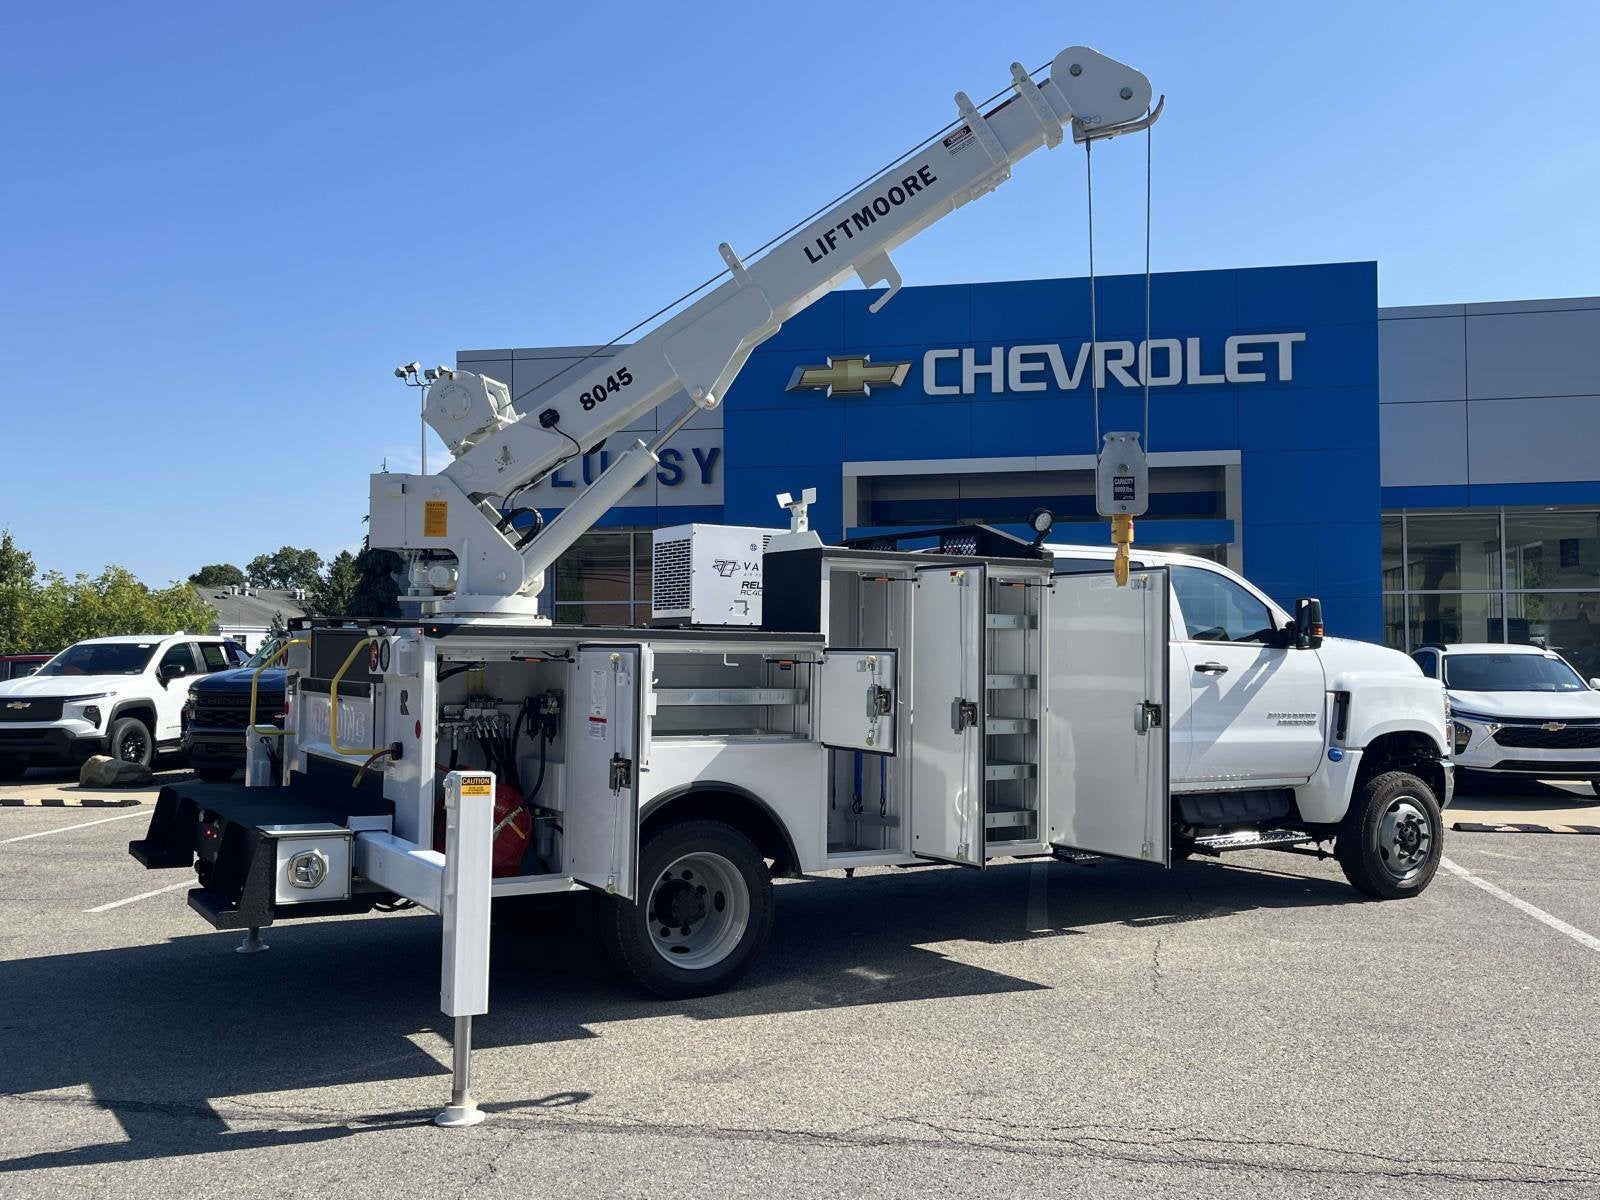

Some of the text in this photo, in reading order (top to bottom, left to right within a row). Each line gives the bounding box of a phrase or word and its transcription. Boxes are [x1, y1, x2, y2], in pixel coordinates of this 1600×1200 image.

[803, 164, 938, 264] LIFTMOORE
[922, 332, 1307, 395] CHEVROLET
[579, 366, 633, 411] 8045
[551, 447, 721, 488] LUSY
[462, 777, 490, 785] CAUTION
